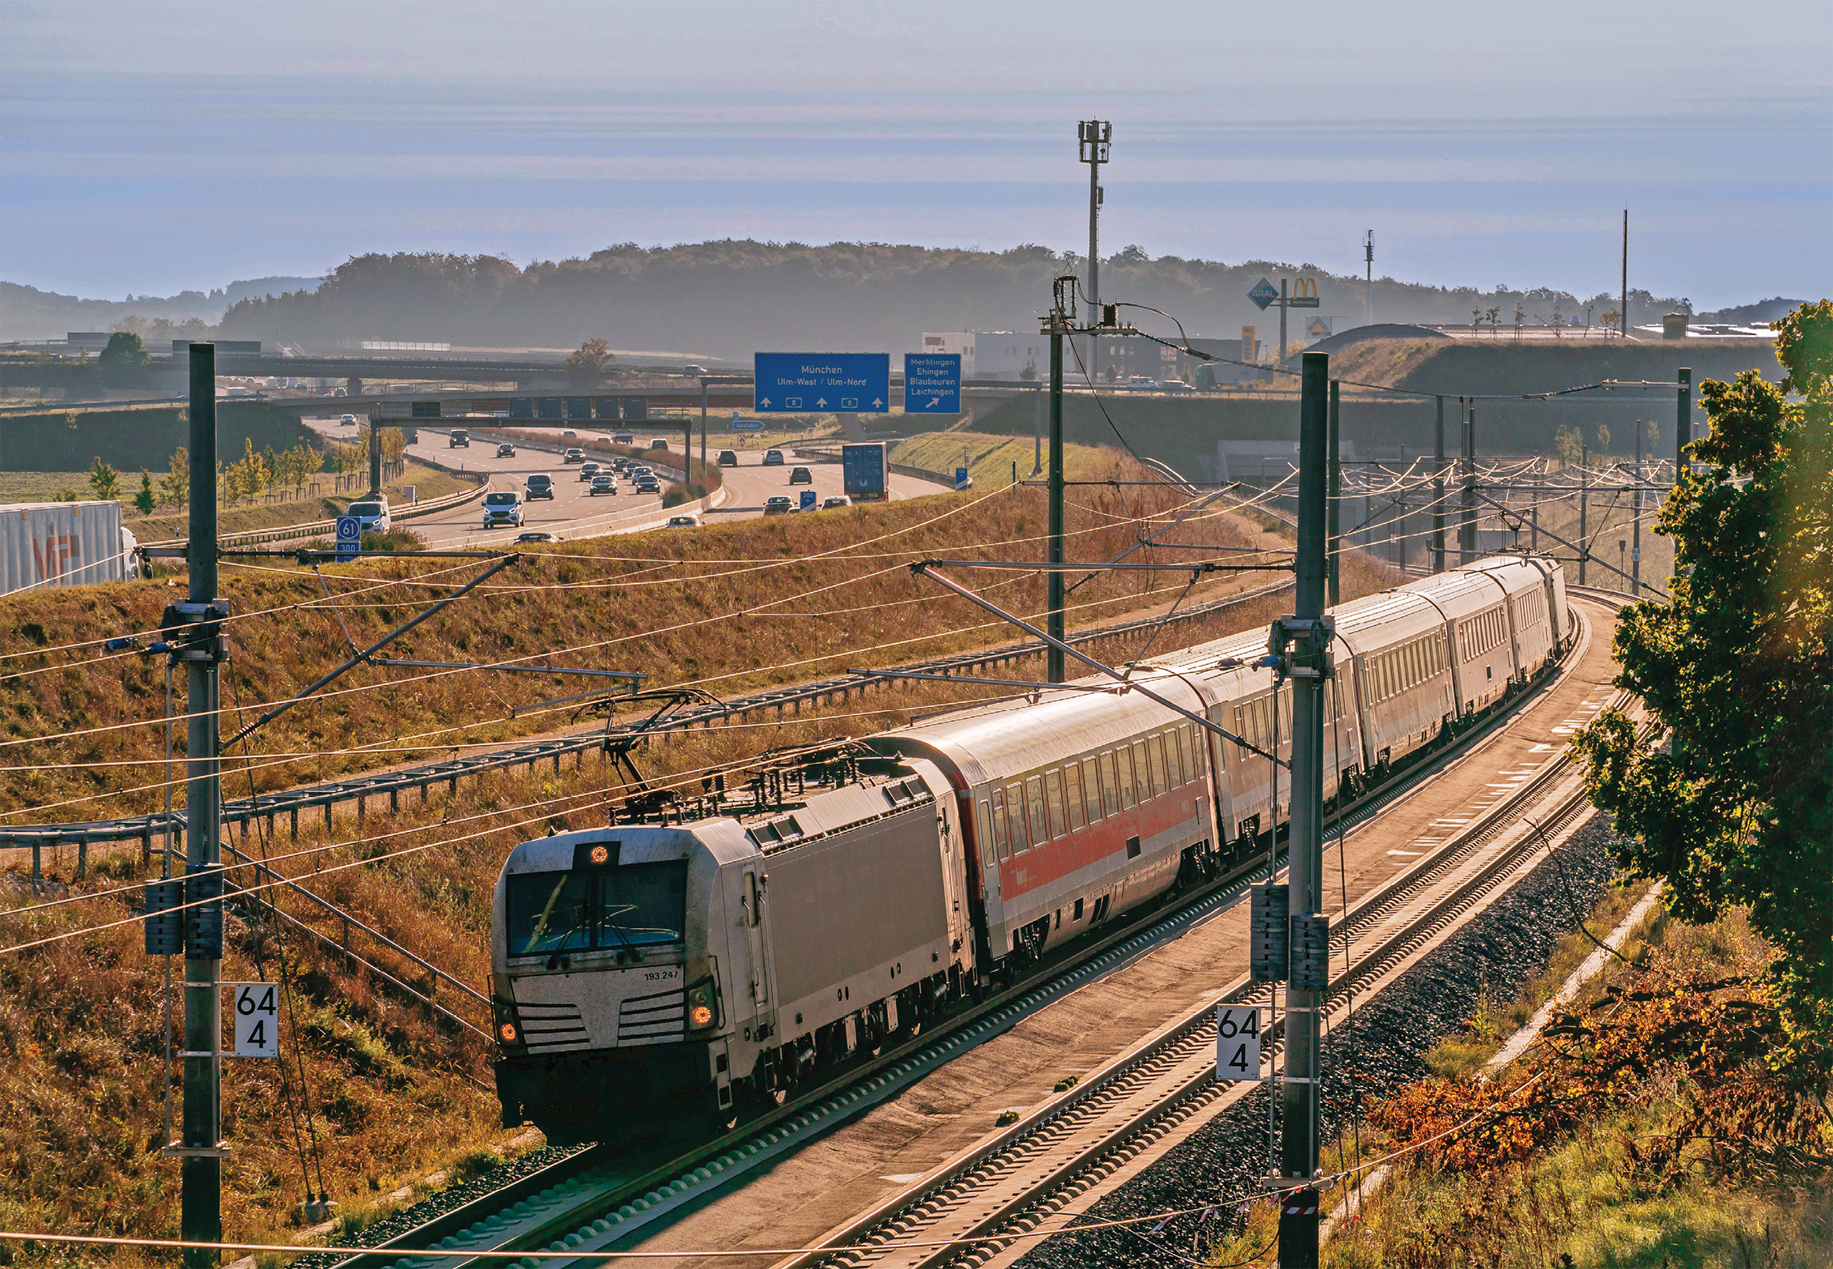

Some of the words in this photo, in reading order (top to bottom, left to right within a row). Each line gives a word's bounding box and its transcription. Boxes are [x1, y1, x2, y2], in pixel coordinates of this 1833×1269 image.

[1252, 289, 1275, 297] ARAL
[910, 358, 955, 368] Merklingen
[801, 365, 843, 374] München
[916, 367, 949, 377] Ehingen
[777, 378, 817, 386] Ulm-West
[826, 378, 867, 386] Ulm-Nord
[909, 377, 956, 386] Blaubeuren
[911, 387, 955, 397] Laichingen
[342, 523, 355, 535] 61
[340, 544, 356, 552] 300
[644, 972, 660, 981] 193
[237, 986, 276, 1015] 64
[1218, 1009, 1259, 1039] 64
[246, 1019, 267, 1048] 4
[1228, 1043, 1249, 1072] 4
